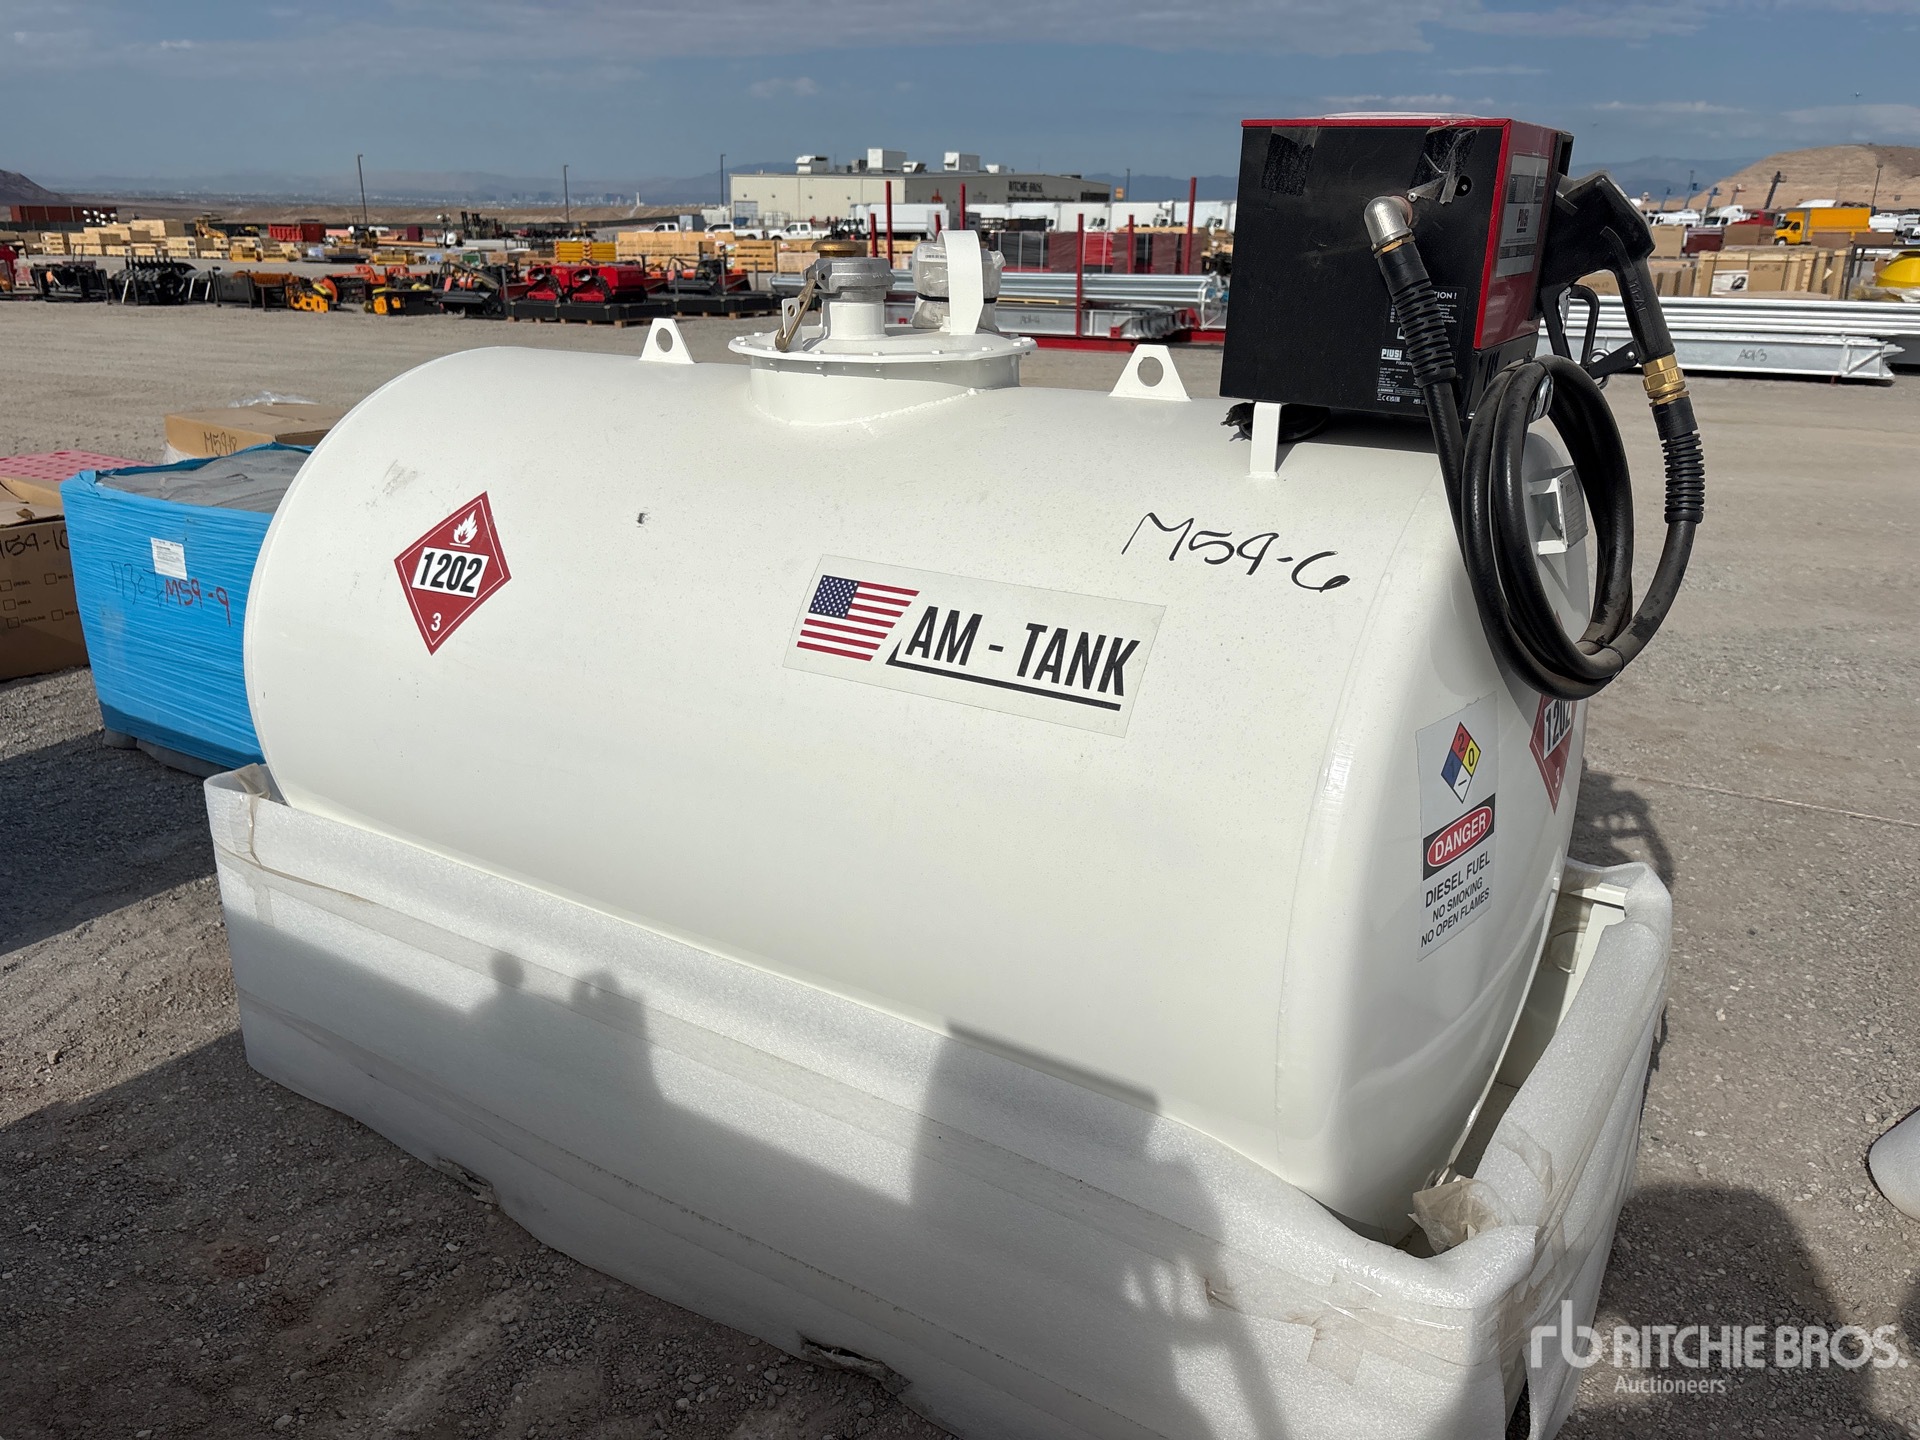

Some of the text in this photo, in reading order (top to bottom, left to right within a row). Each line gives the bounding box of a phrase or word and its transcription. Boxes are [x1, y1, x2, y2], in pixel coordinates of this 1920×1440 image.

[1381, 348, 1402, 360] PIUSI
[419, 551, 483, 594] 1202
[1121, 512, 1350, 593] M59-6
[164, 578, 231, 628] M59-9
[430, 612, 442, 632] 3
[905, 605, 983, 666] AM
[1016, 622, 1141, 697] TANK
[1457, 733, 1465, 753] 2
[1468, 747, 1475, 767] 0
[1554, 766, 1560, 789] 3
[1434, 812, 1486, 862] DANGER
[1425, 850, 1491, 908] DIESEL FUEL
[1432, 877, 1483, 922] NO SMOKING
[1420, 887, 1490, 948] NO OPEN FLAMES
